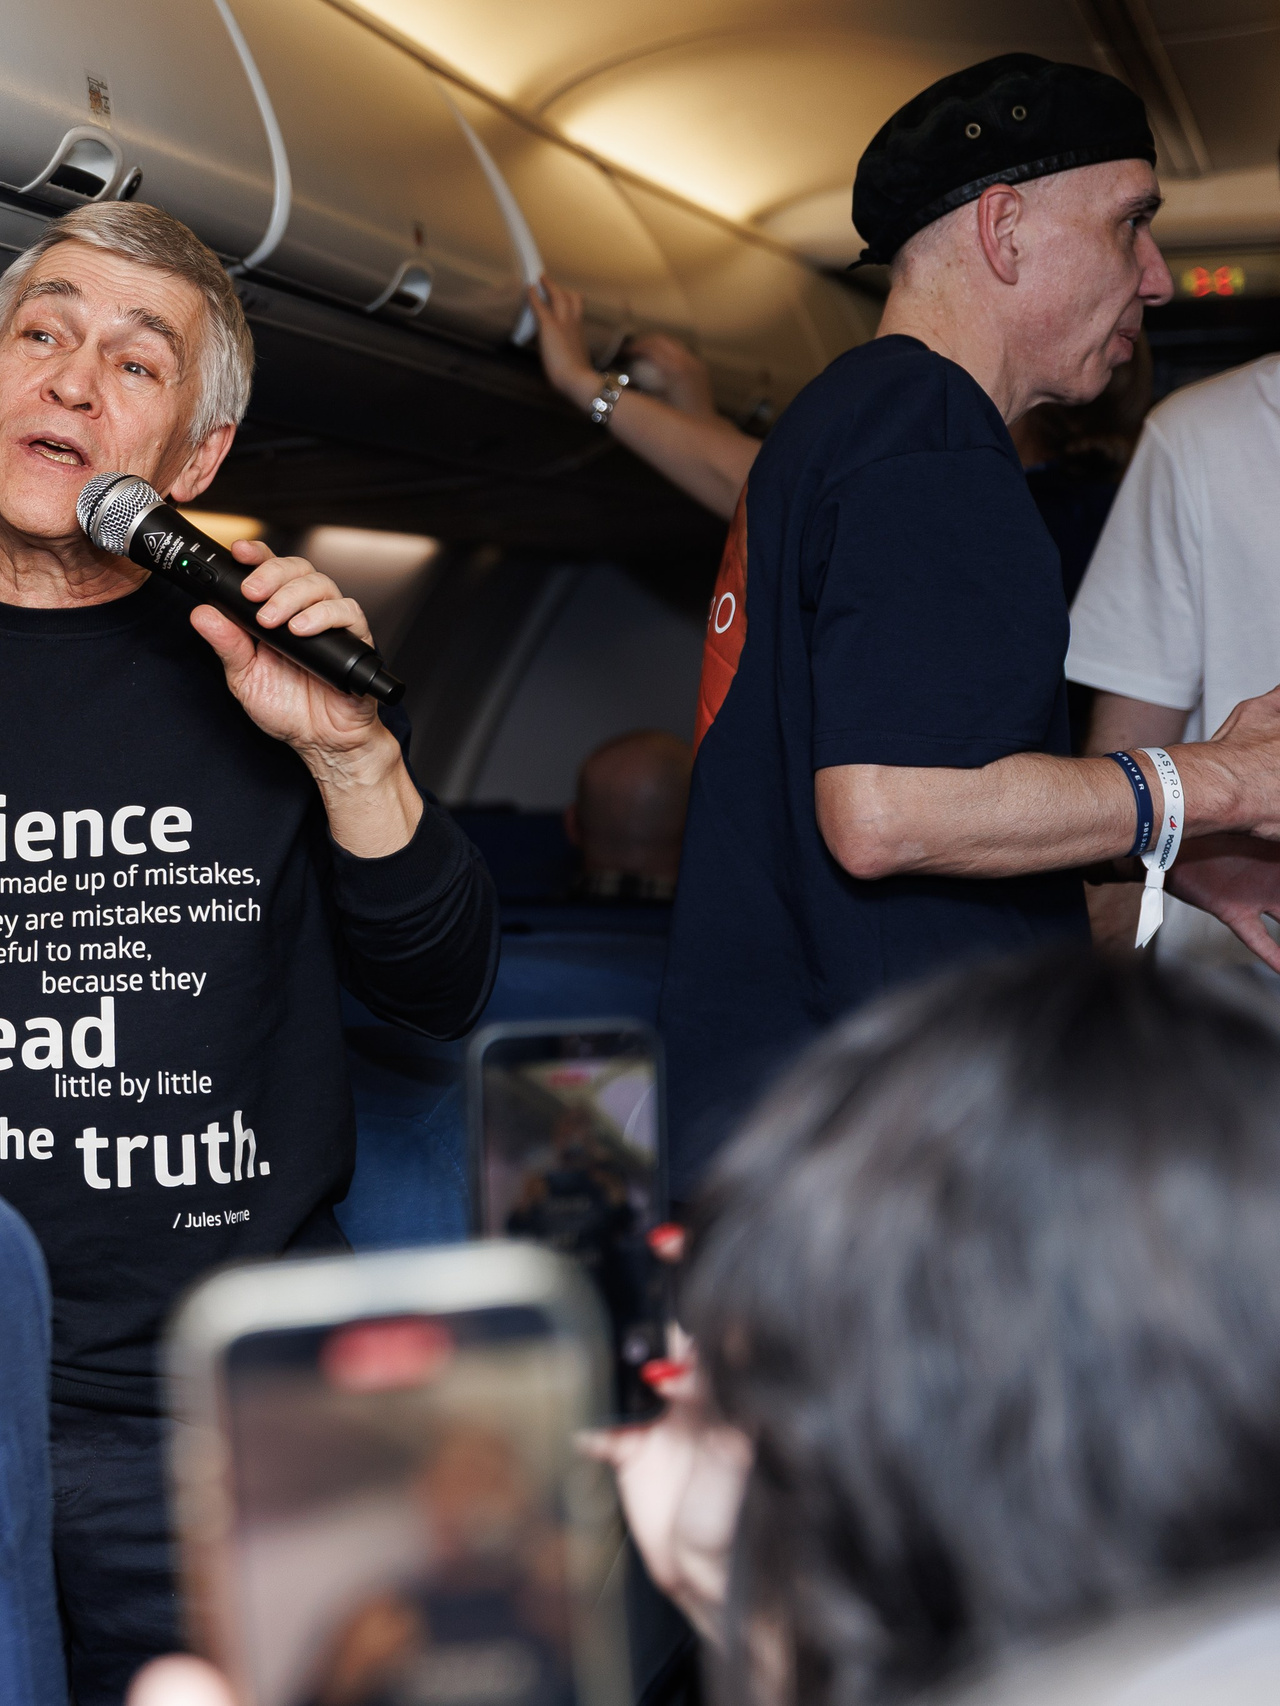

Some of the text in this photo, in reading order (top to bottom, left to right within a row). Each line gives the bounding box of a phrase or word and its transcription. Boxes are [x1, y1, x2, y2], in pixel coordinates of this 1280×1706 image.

[1157, 752, 1180, 799] ASTRO
[1158, 834, 1175, 869] РОСКОСМОС
[0, 870, 67, 894] made
[76, 872, 105, 896] up
[114, 864, 139, 888] of
[146, 862, 260, 886] mistakes,
[25, 912, 63, 930] are
[73, 901, 181, 927] mistakes
[188, 898, 260, 922] which
[46, 942, 71, 961] to
[80, 936, 151, 961] make,
[42, 967, 206, 996] because they
[55, 1070, 212, 1103] little by little
[75, 1110, 270, 1189] truth.
[185, 1212, 221, 1227] Jules
[224, 1210, 249, 1224] Verne
